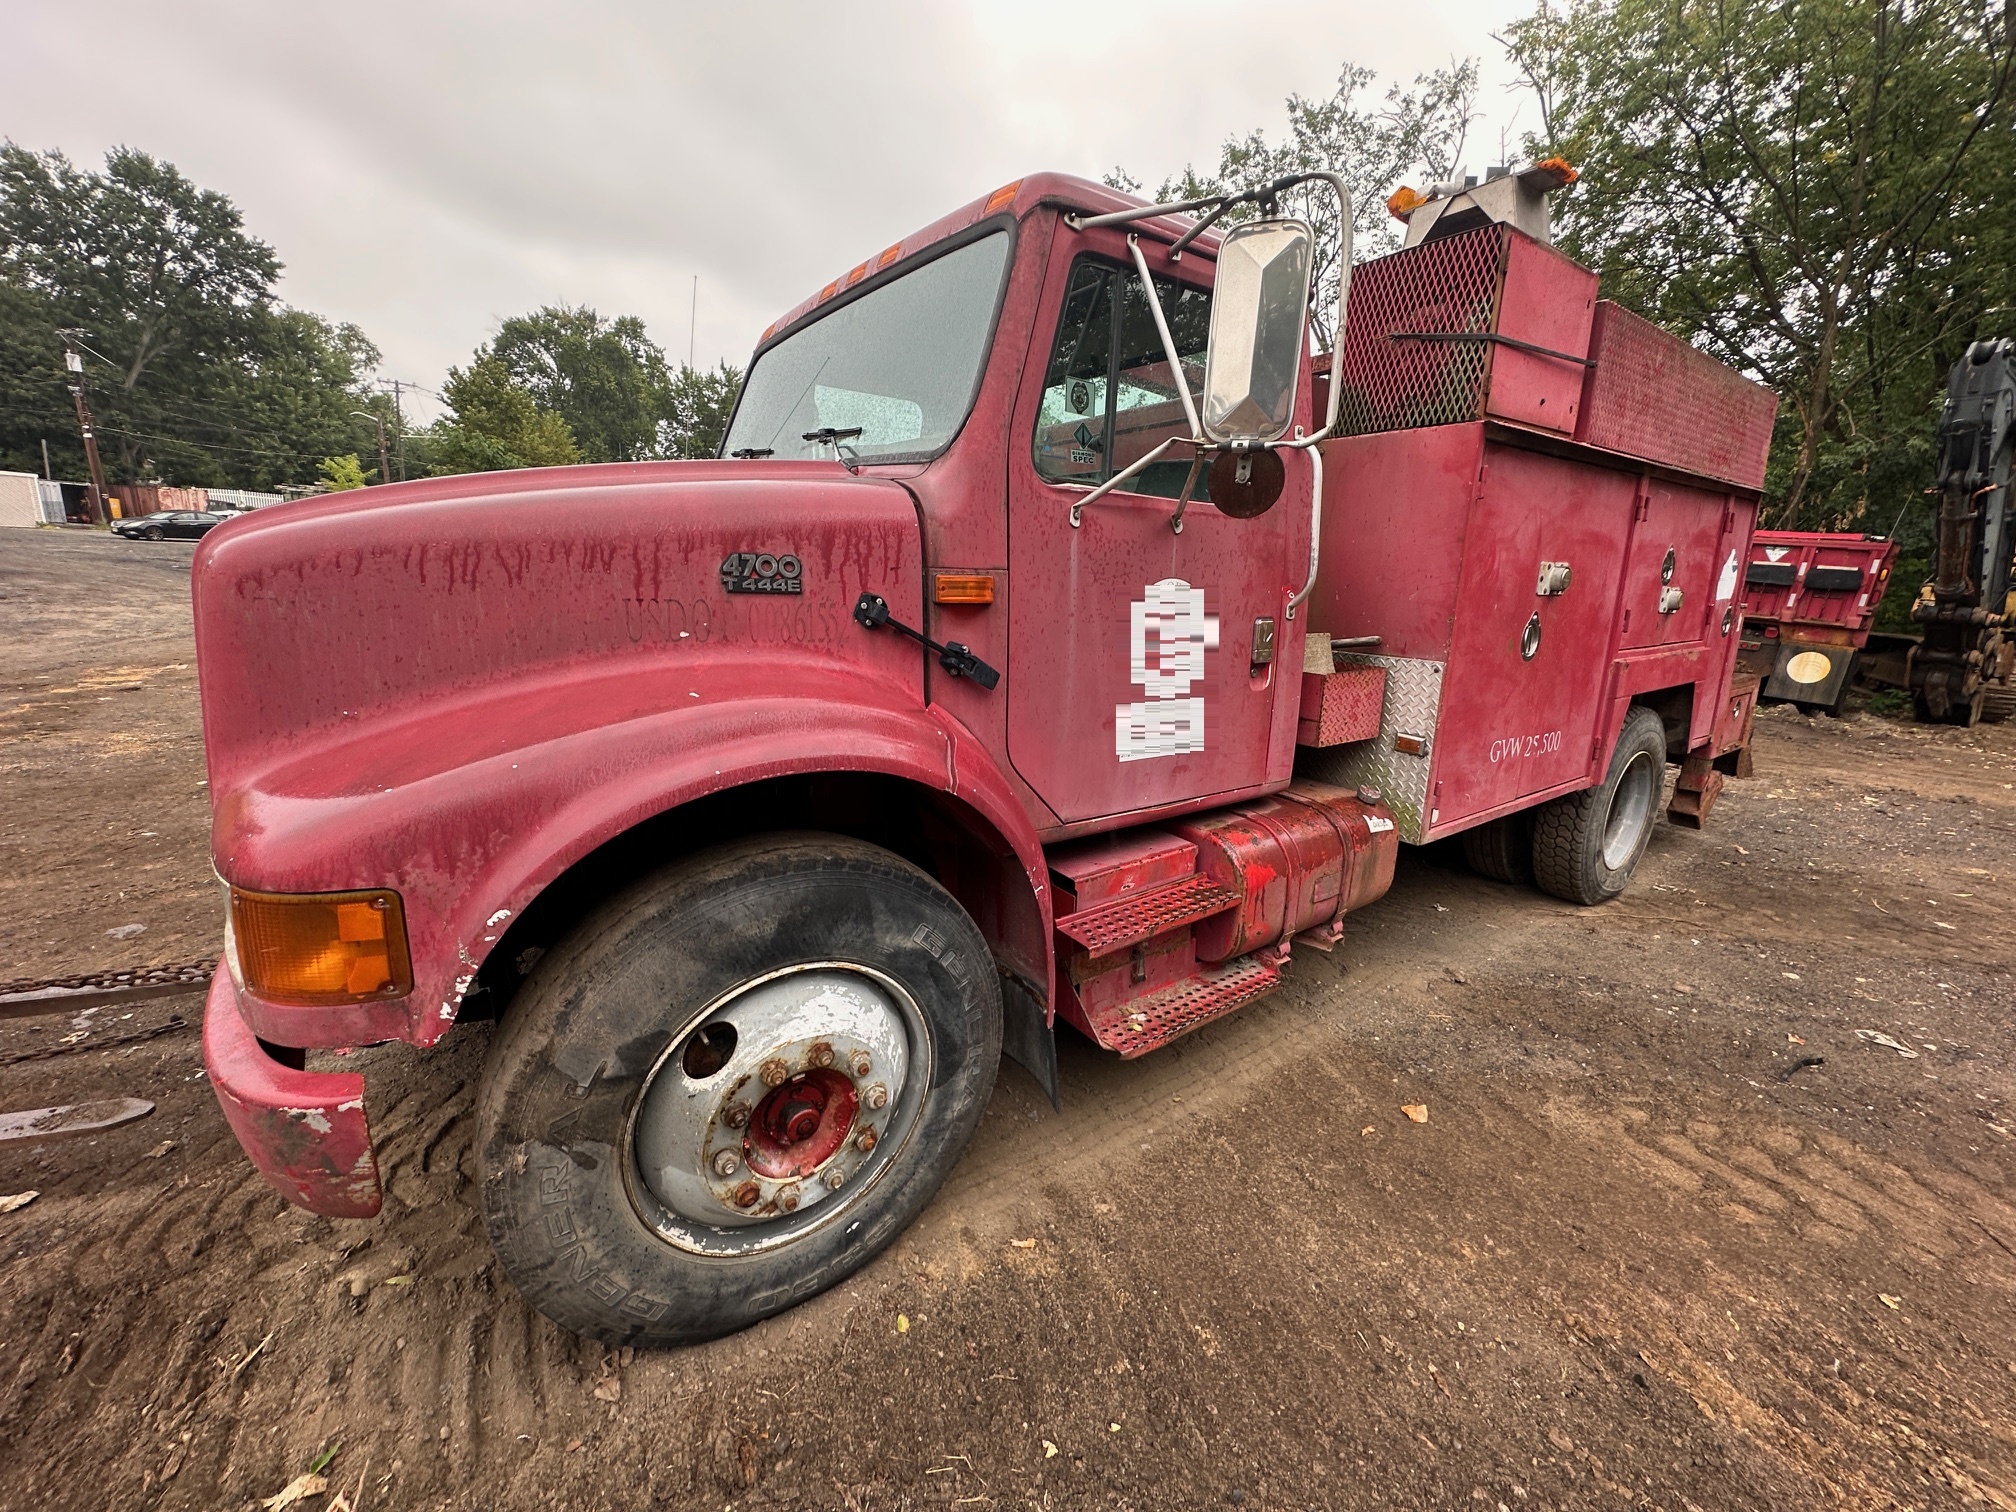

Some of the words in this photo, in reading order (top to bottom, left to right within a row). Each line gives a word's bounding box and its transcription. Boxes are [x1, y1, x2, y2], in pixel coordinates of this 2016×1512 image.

[722, 553, 801, 578] 4700
[723, 577, 738, 590] T
[742, 578, 801, 592] 444E
[1490, 735, 1525, 763] GVW
[537, 1060, 670, 1322] GENERAL
